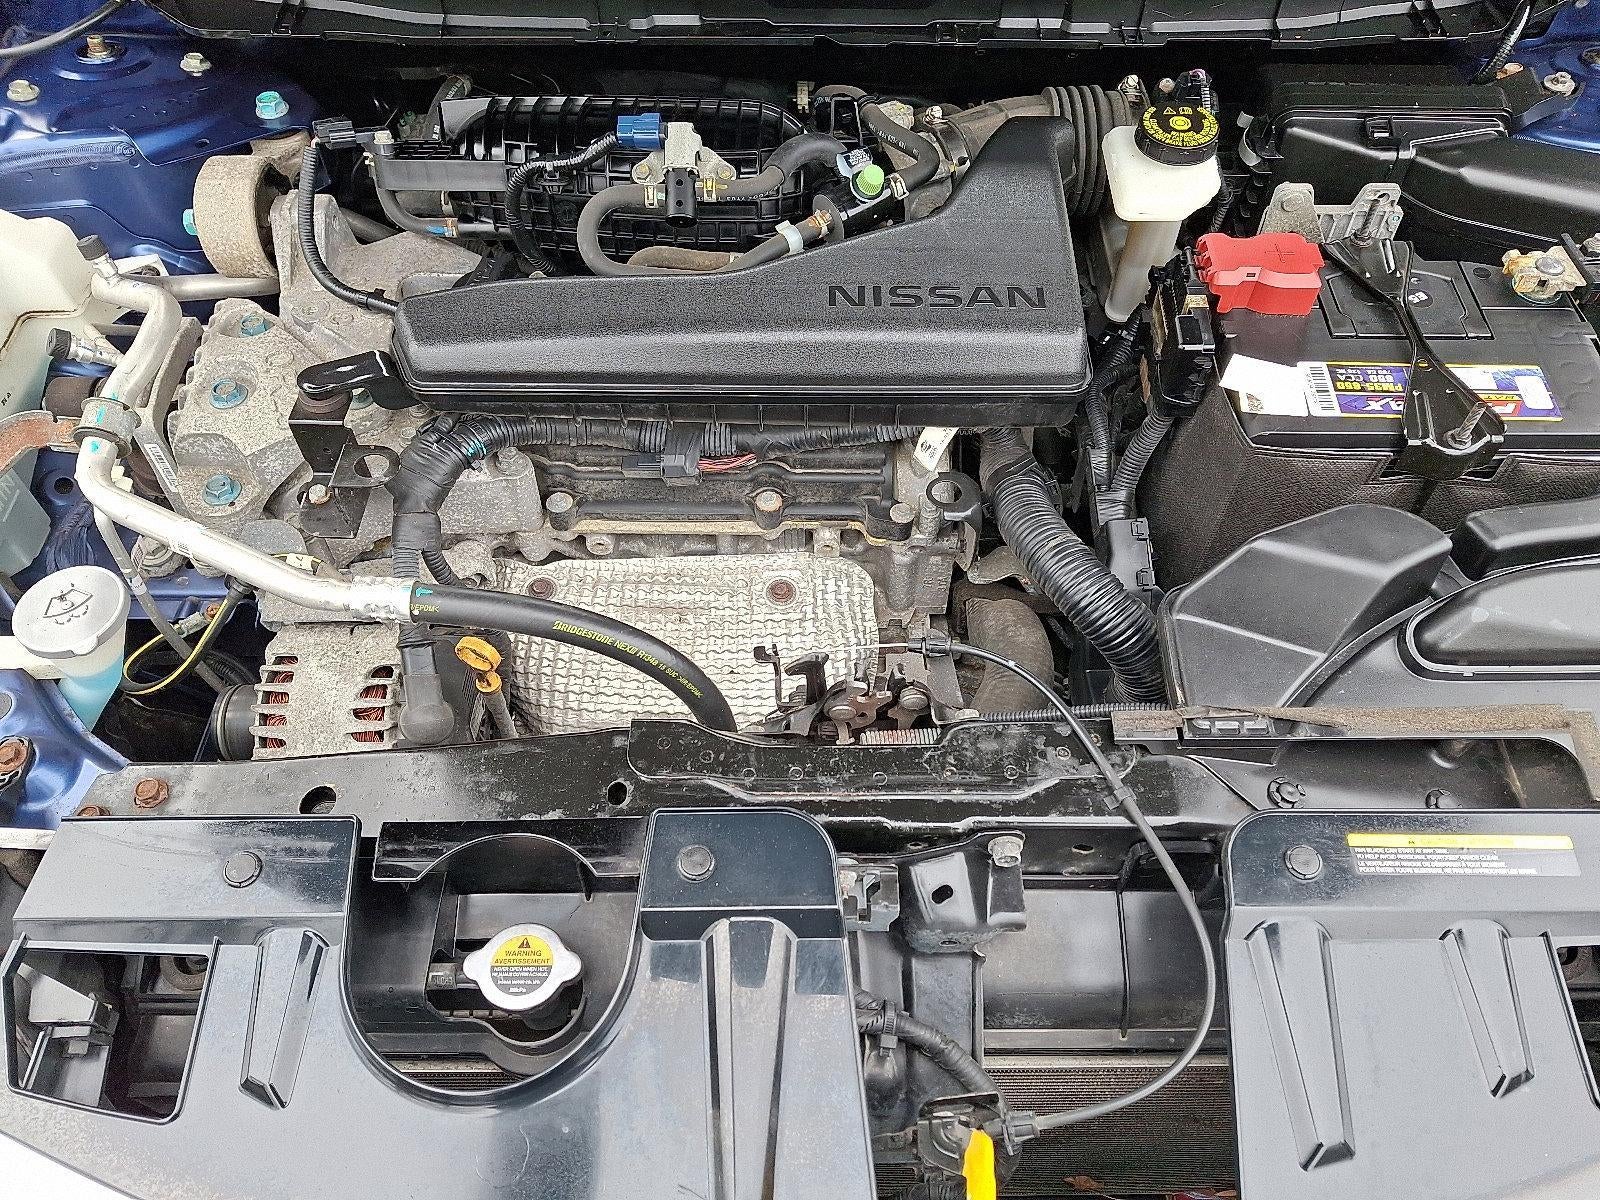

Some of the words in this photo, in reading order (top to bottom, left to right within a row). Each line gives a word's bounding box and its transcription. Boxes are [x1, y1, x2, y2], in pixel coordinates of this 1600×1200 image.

[828, 285, 1047, 310] NISSAN
[1336, 374, 1364, 382] CCA
[553, 620, 615, 645] BRIDGESTONE
